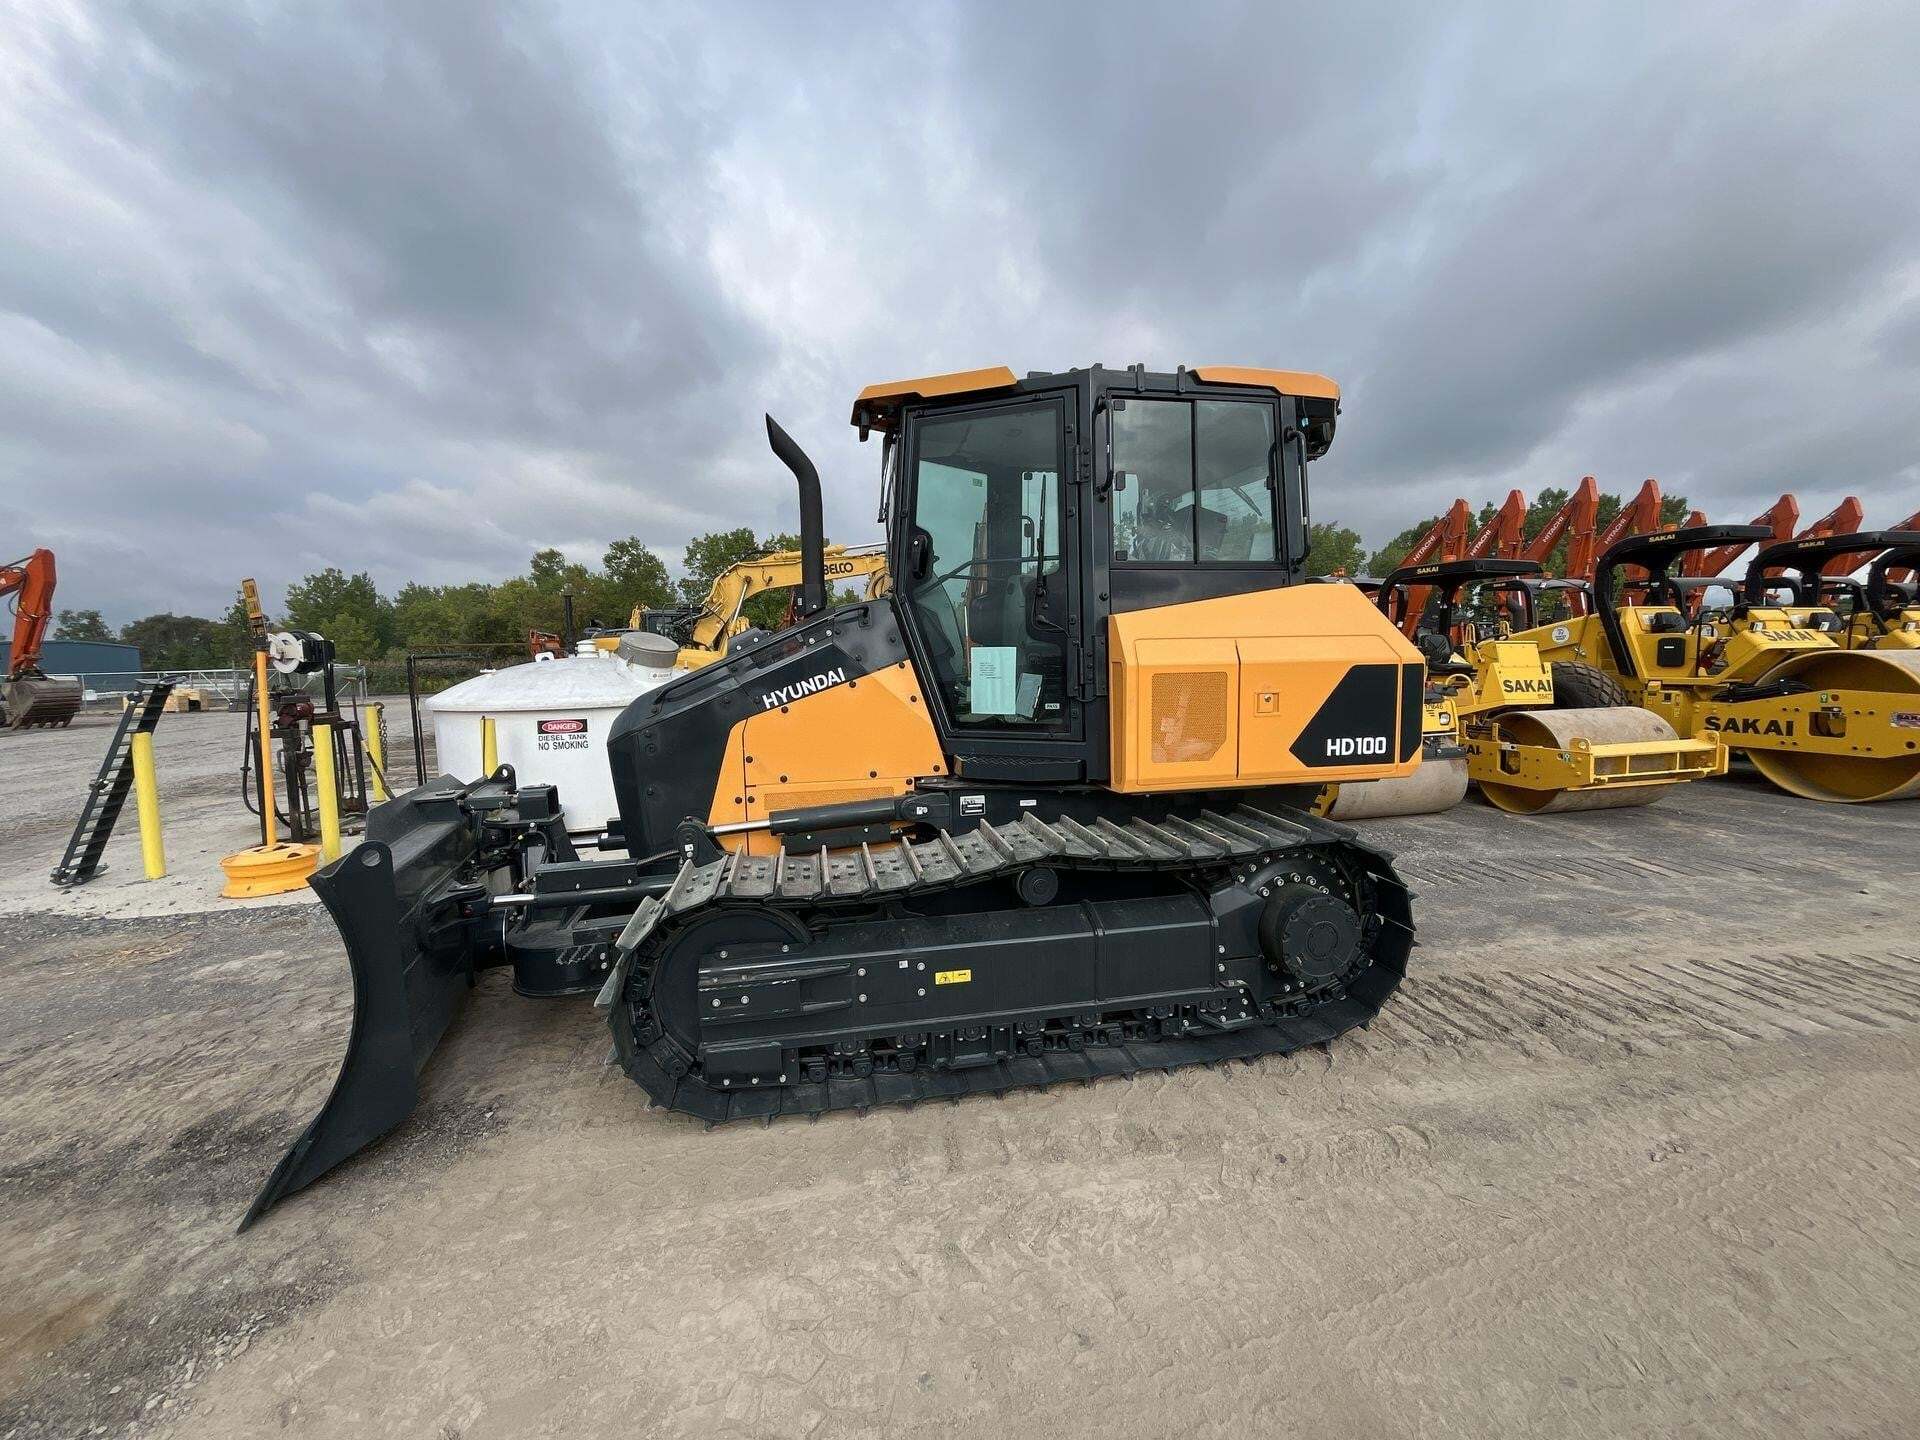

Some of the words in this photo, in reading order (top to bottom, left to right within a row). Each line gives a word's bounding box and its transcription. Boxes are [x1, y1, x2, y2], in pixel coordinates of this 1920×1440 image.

[1542, 516, 1564, 543] HITACHI
[1604, 517, 1627, 544] HITACHI
[1469, 529, 1492, 556] HITACHI
[1648, 534, 1676, 543] SAKAI
[1798, 540, 1825, 549] SAKAI
[1412, 535, 1436, 562] HITACHI
[823, 562, 854, 575] BELCO
[1416, 566, 1439, 575] SAKAI
[1761, 629, 1817, 642] SAKAI
[762, 667, 846, 710] HYUNDAI
[1502, 679, 1553, 693] SAKAI
[547, 722, 578, 731] DANGER
[1704, 715, 1795, 737] SAKAI
[538, 742, 550, 751] NO
[552, 741, 589, 750] SMOKING
[1326, 736, 1387, 757] HD100
